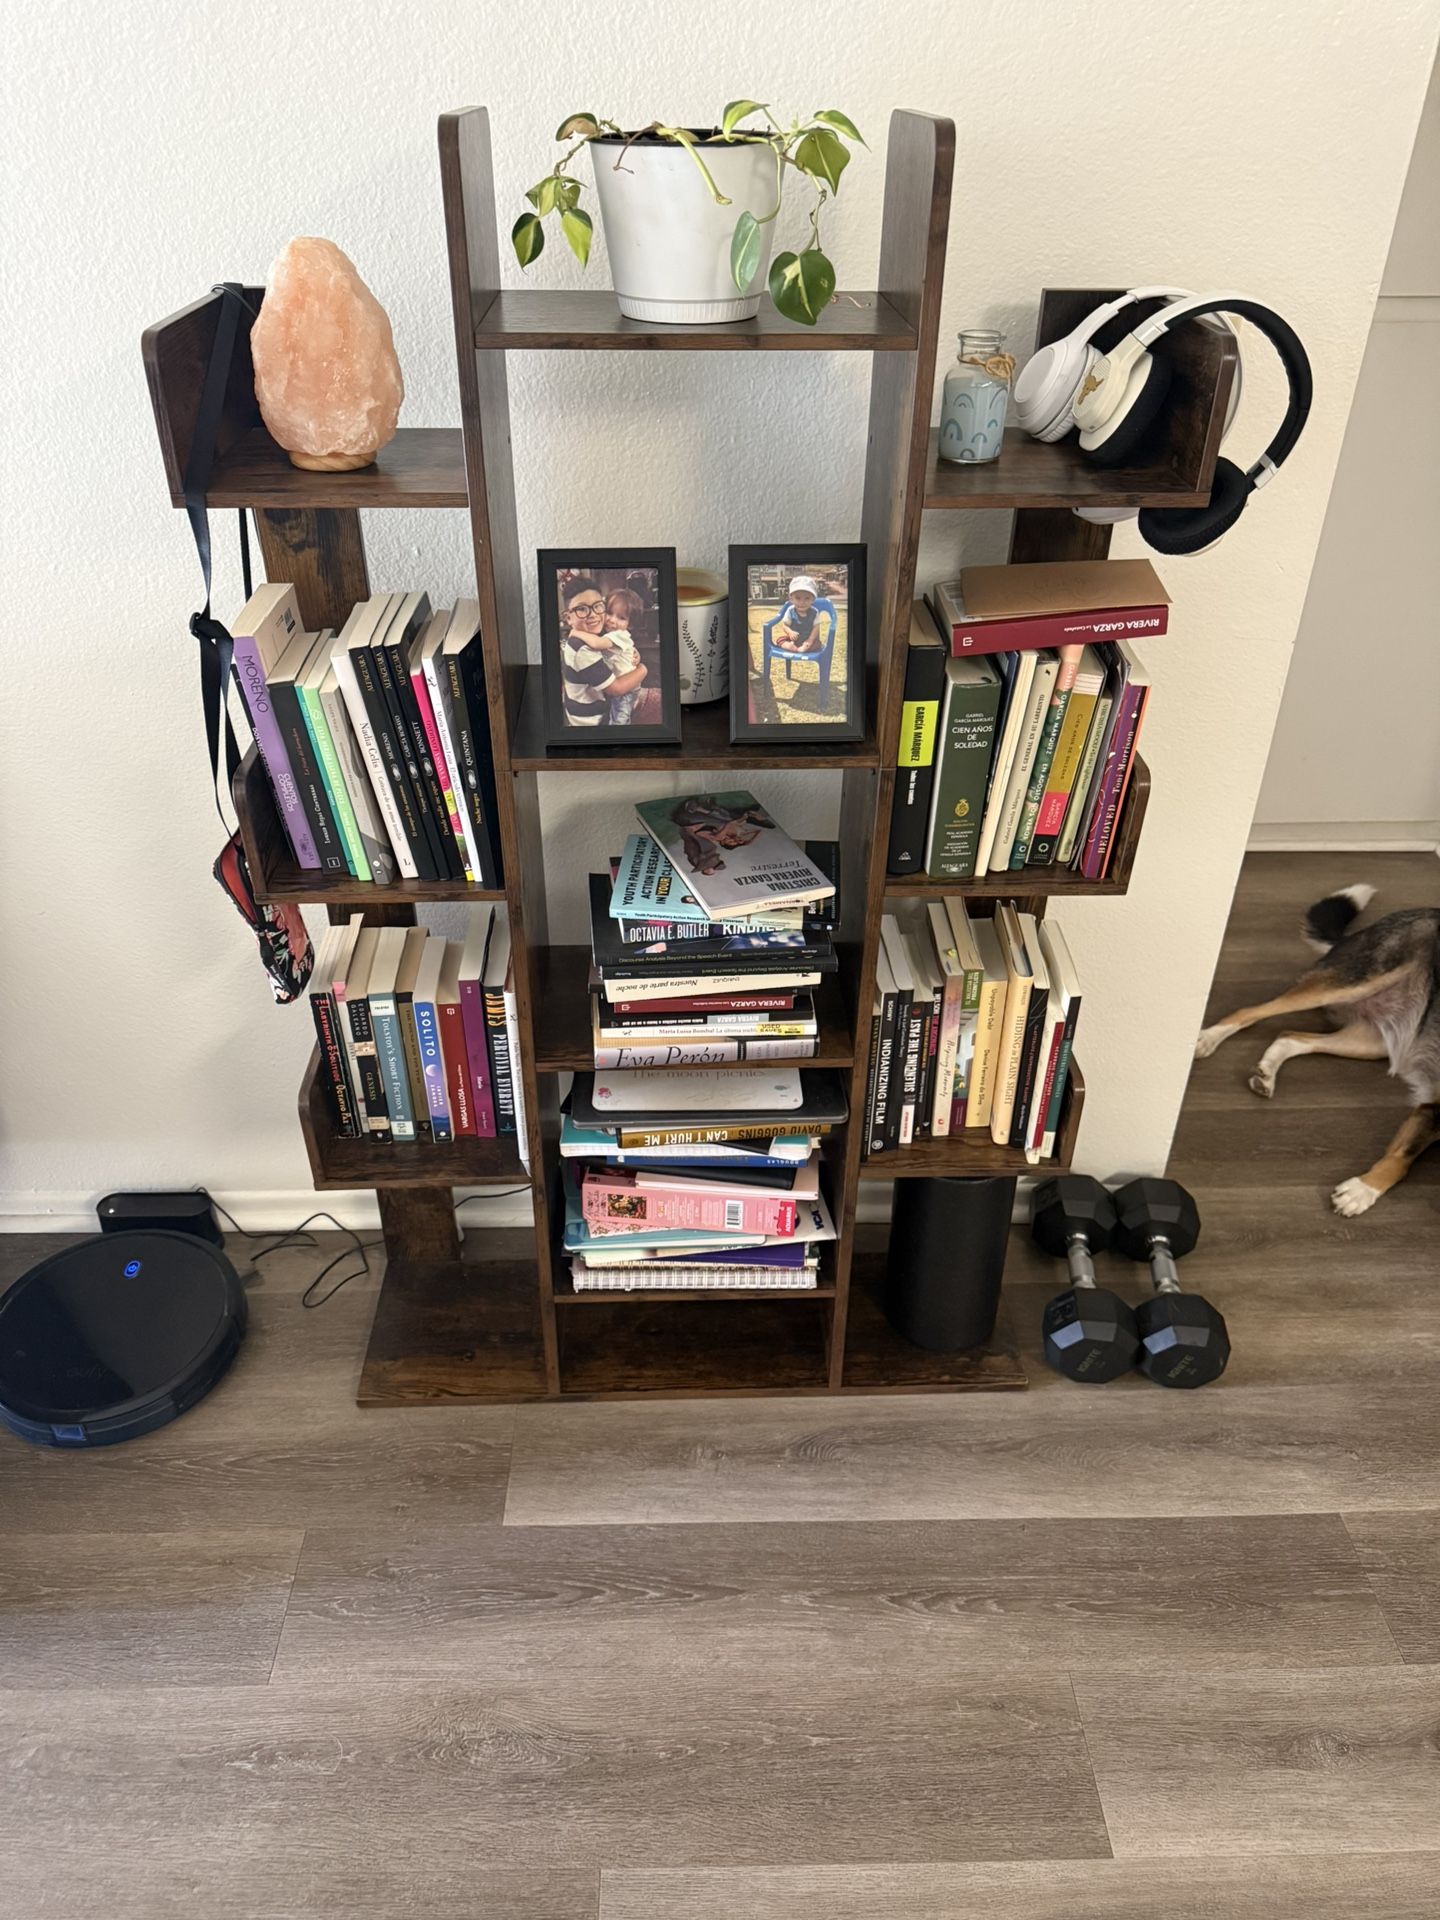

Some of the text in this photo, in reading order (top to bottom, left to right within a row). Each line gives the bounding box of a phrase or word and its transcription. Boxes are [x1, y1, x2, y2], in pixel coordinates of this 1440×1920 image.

[1092, 618, 1159, 632] RIVERA GARZA
[357, 654, 374, 693] ALFAGUARA
[375, 651, 392, 689] ALFAGUARA
[390, 648, 407, 686] ALFAGUARA
[448, 659, 460, 698] ALFAGUARA
[241, 653, 269, 713] MORENO
[1023, 740, 1033, 763] GENERAL
[1033, 693, 1044, 723] LABERINTO
[1045, 694, 1067, 755] GARCÍA MÁRQUEZ
[1096, 703, 1108, 730] VIRGINIA
[359, 721, 381, 768] Nadia Celis
[381, 731, 394, 760] MORENO
[411, 719, 426, 753] BONNETT
[460, 730, 473, 766] QUINTANA
[910, 706, 926, 762] GARCÍA MÁRQUEZ
[1091, 730, 1100, 749] WOOLF
[1111, 730, 1133, 794] Toni Morrison
[277, 773, 294, 812] COMPLETOS
[283, 772, 298, 804] CUENTOS
[1022, 762, 1047, 841] EN AGOSTO VEMOS
[1096, 803, 1116, 854] BELOVED
[622, 836, 648, 906] YOUTH PARTICIPATORY
[733, 867, 812, 886] RIVERA GARZA
[750, 859, 800, 870] Terrestre
[640, 874, 654, 899] ACTION
[657, 876, 670, 895] YOUR
[766, 877, 820, 891] CRISTINA
[655, 895, 666, 904] IN
[629, 923, 709, 942] OCTAVIA E. BUTLER
[615, 984, 637, 992] noche
[670, 979, 697, 987] Nuestra
[933, 993, 941, 1014] NELSON
[988, 988, 997, 1016] Unpayable
[350, 1003, 360, 1036] GALEANO
[357, 1003, 368, 1035] EDUARDO
[420, 1010, 435, 1056] SOLITO
[1012, 1014, 1024, 1049] HIDING
[616, 1047, 655, 1066] Eva
[665, 1045, 724, 1065] Perón
[903, 1017, 920, 1092] SILENCING THE PAST
[1008, 1056, 1018, 1079] PLAIN
[365, 1072, 376, 1101] GENESIS
[492, 1033, 513, 1116] PERCIVAL EVERETT
[667, 1070, 709, 1078] moon
[875, 1038, 891, 1124] INDIANIZING FILM
[335, 1083, 352, 1124] OCTAVIO PAZ
[457, 1088, 465, 1105] LLOSA
[1004, 1080, 1014, 1105] SIGHT
[459, 1106, 468, 1128] VARGAS
[737, 1124, 821, 1139] DAVID GOGGINS
[643, 1130, 728, 1144] CAN'T HURT ME
[1168, 1354, 1194, 1378] IGNITE
